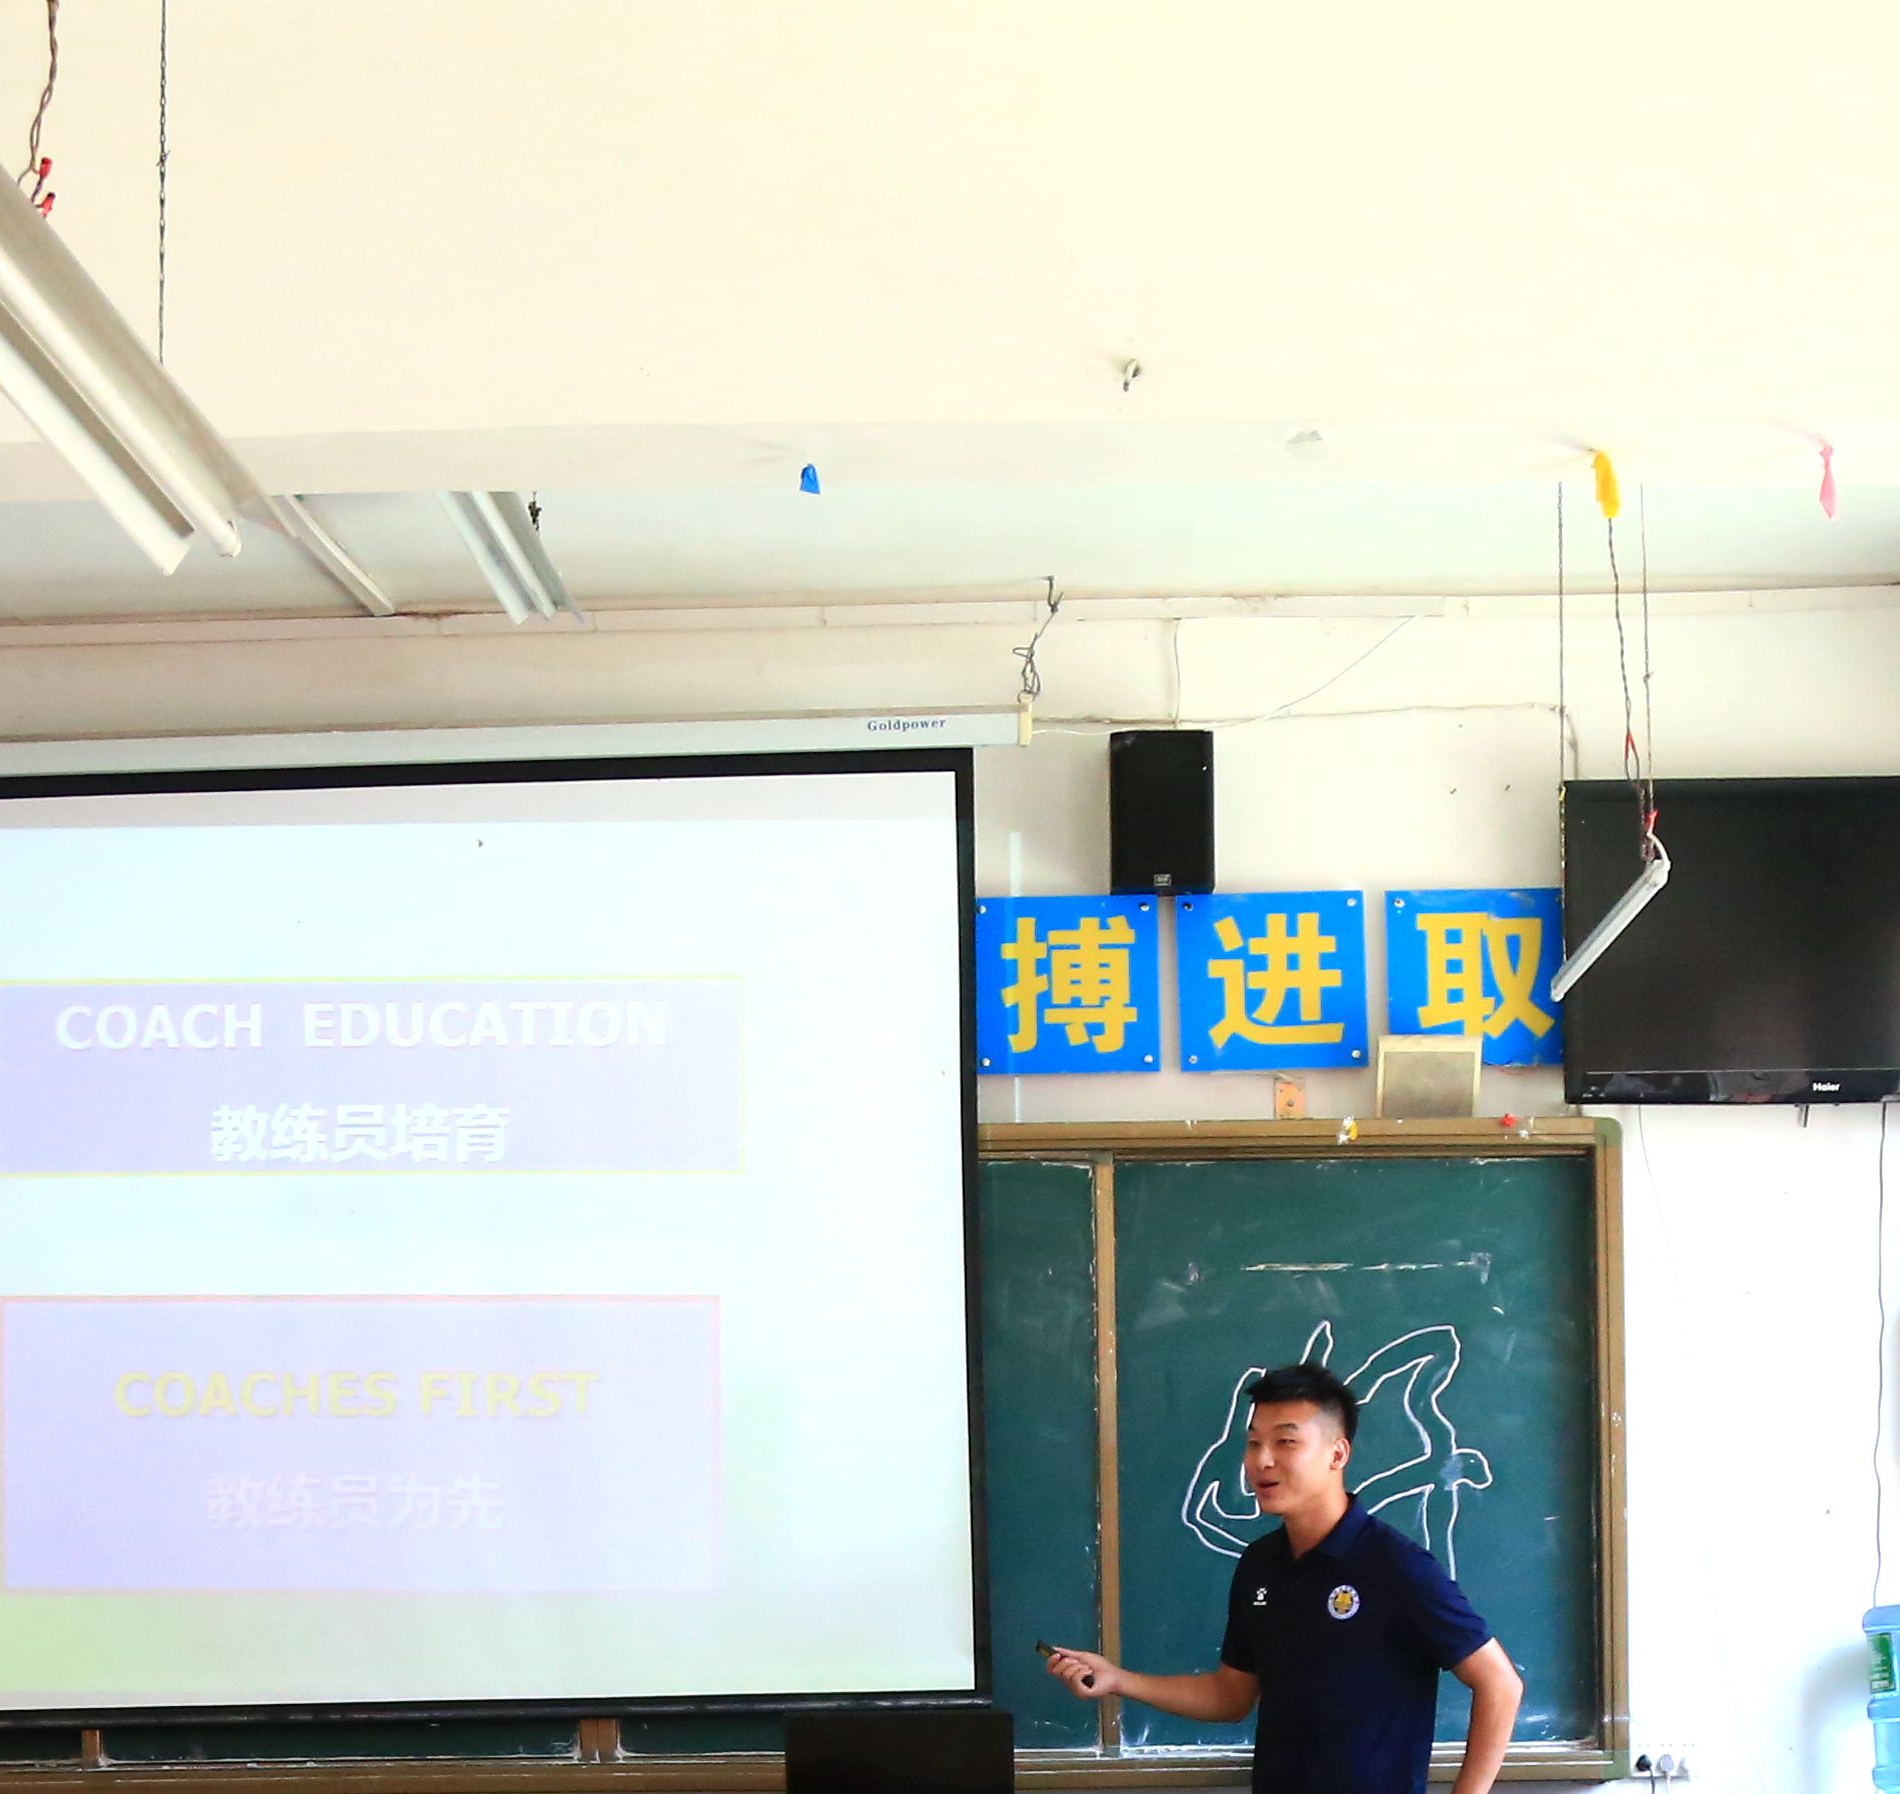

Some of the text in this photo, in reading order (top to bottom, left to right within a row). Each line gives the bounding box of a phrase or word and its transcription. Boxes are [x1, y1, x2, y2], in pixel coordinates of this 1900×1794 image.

[867, 718, 947, 732] Goldpower
[1001, 911, 1556, 1055] 搏进取
[56, 999, 670, 1050] COACH EDUCATION
[1812, 1081, 1841, 1092] Haier
[210, 1102, 512, 1164] 教练员培育
[114, 1368, 603, 1420] COACHES FIRST
[205, 1472, 506, 1532] 教练员为先
